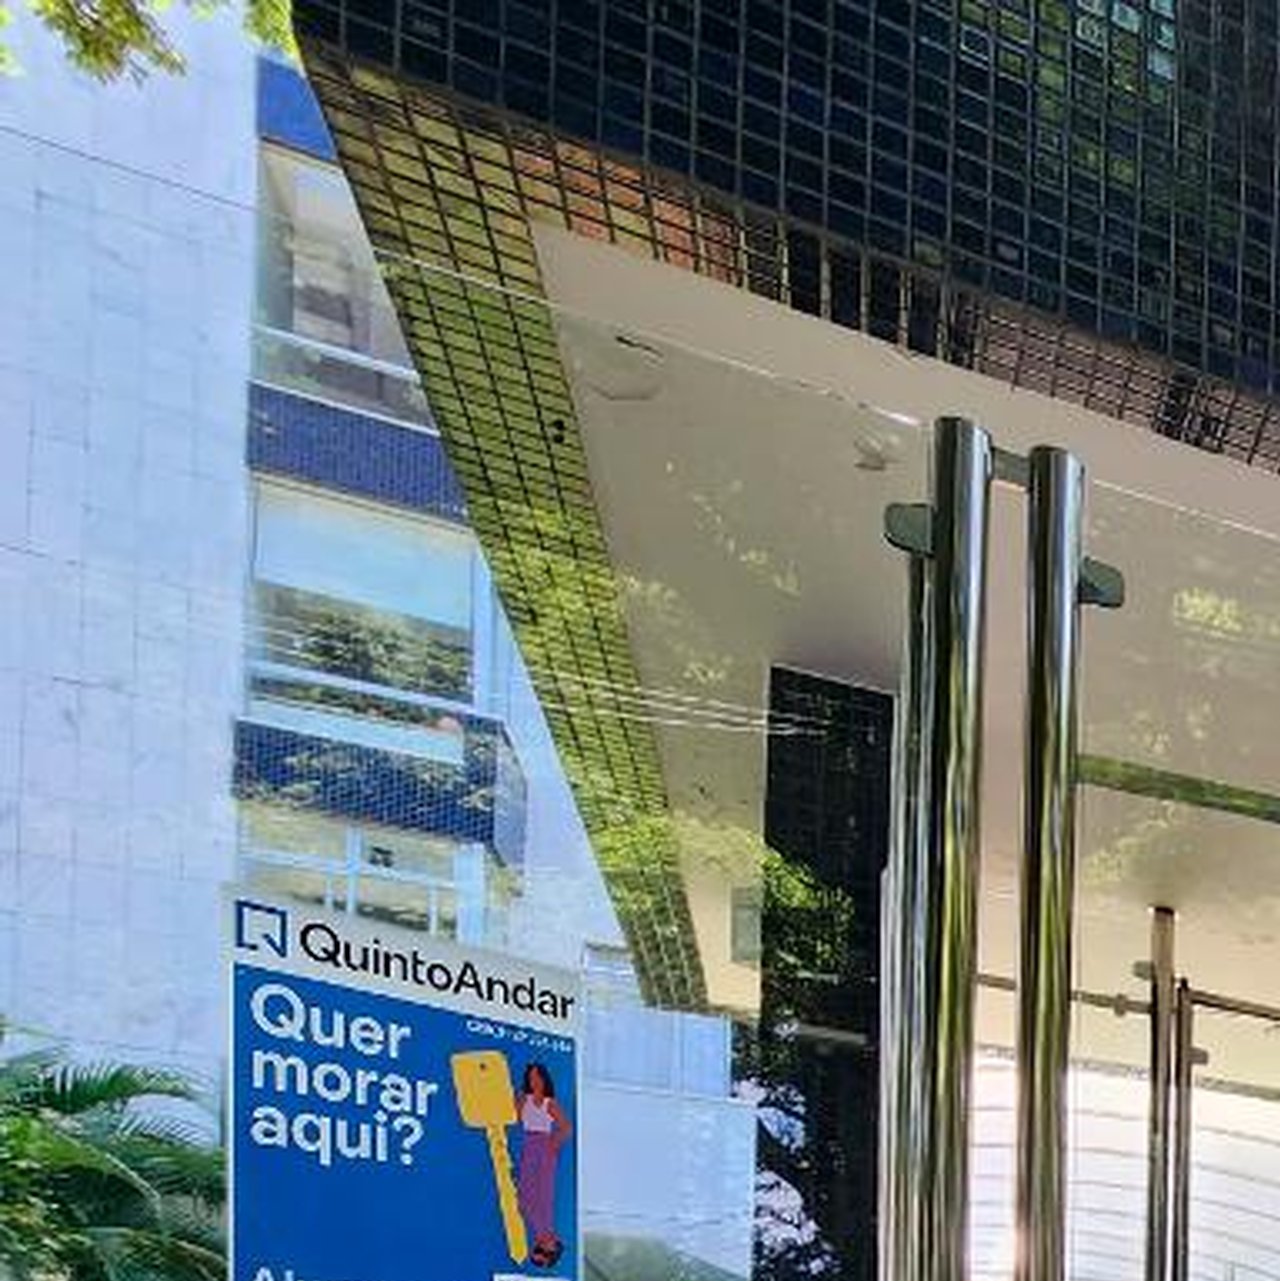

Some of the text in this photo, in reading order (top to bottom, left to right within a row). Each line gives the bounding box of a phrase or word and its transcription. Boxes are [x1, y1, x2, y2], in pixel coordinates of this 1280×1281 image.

[299, 922, 574, 1019] QuintoAndar
[251, 982, 412, 1059] Quer
[252, 1050, 437, 1117] morar
[252, 1108, 424, 1167] aqui?
